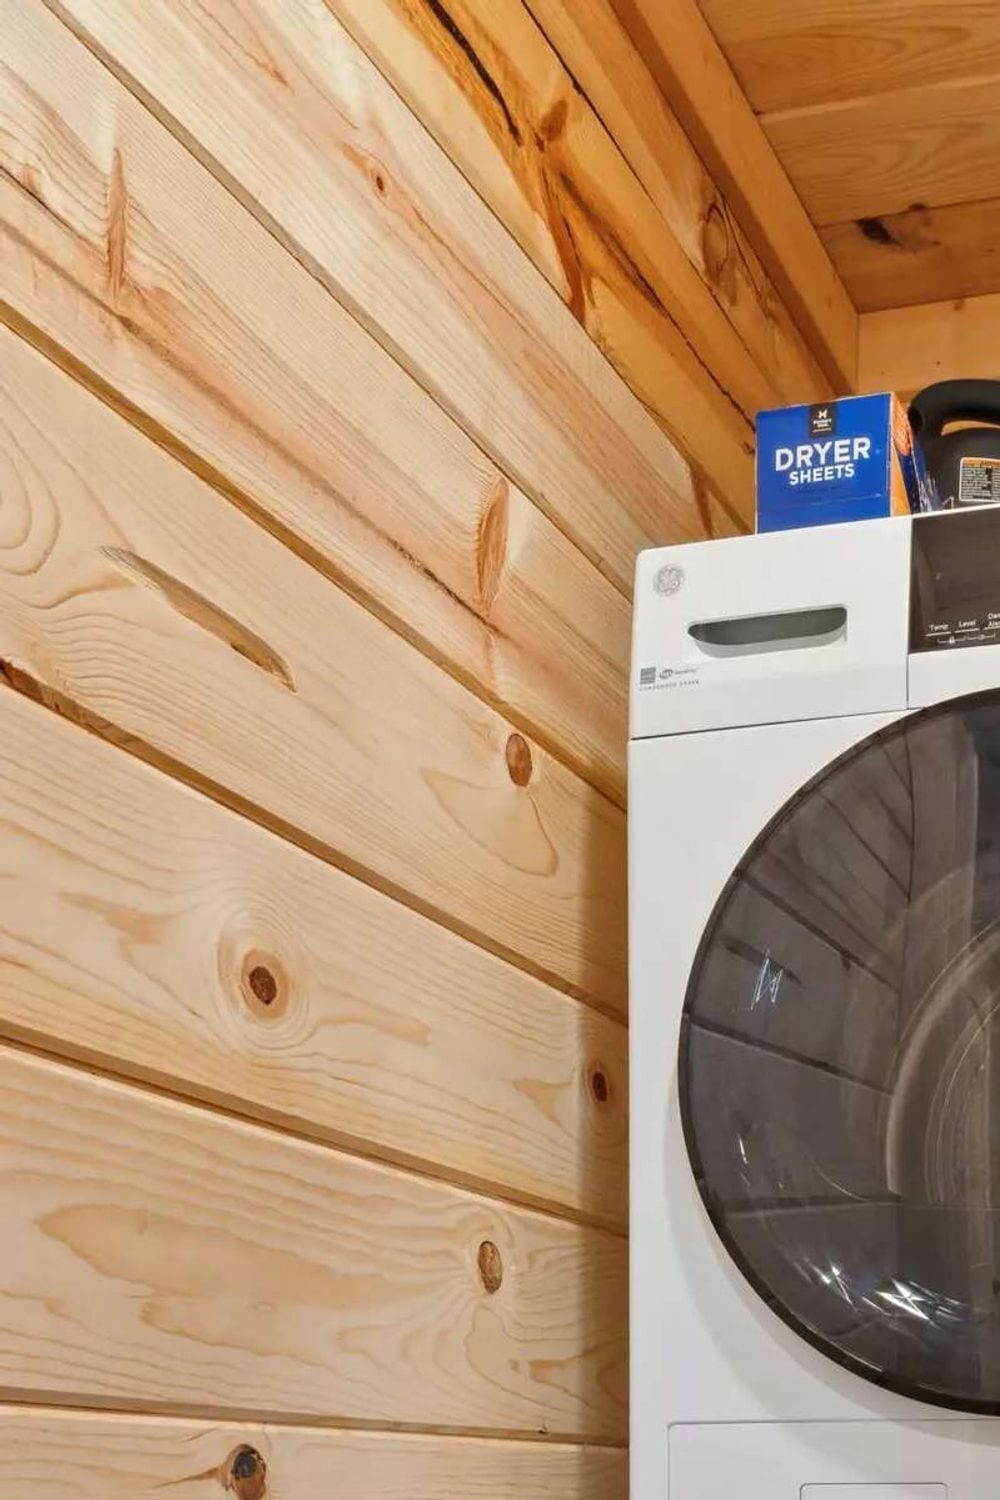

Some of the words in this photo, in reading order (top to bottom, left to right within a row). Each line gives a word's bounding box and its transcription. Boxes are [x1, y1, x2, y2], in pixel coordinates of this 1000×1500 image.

[775, 437, 871, 472] DRYER
[789, 463, 855, 486] SHEETS
[930, 624, 949, 632] Temp
[959, 620, 976, 628] Level
